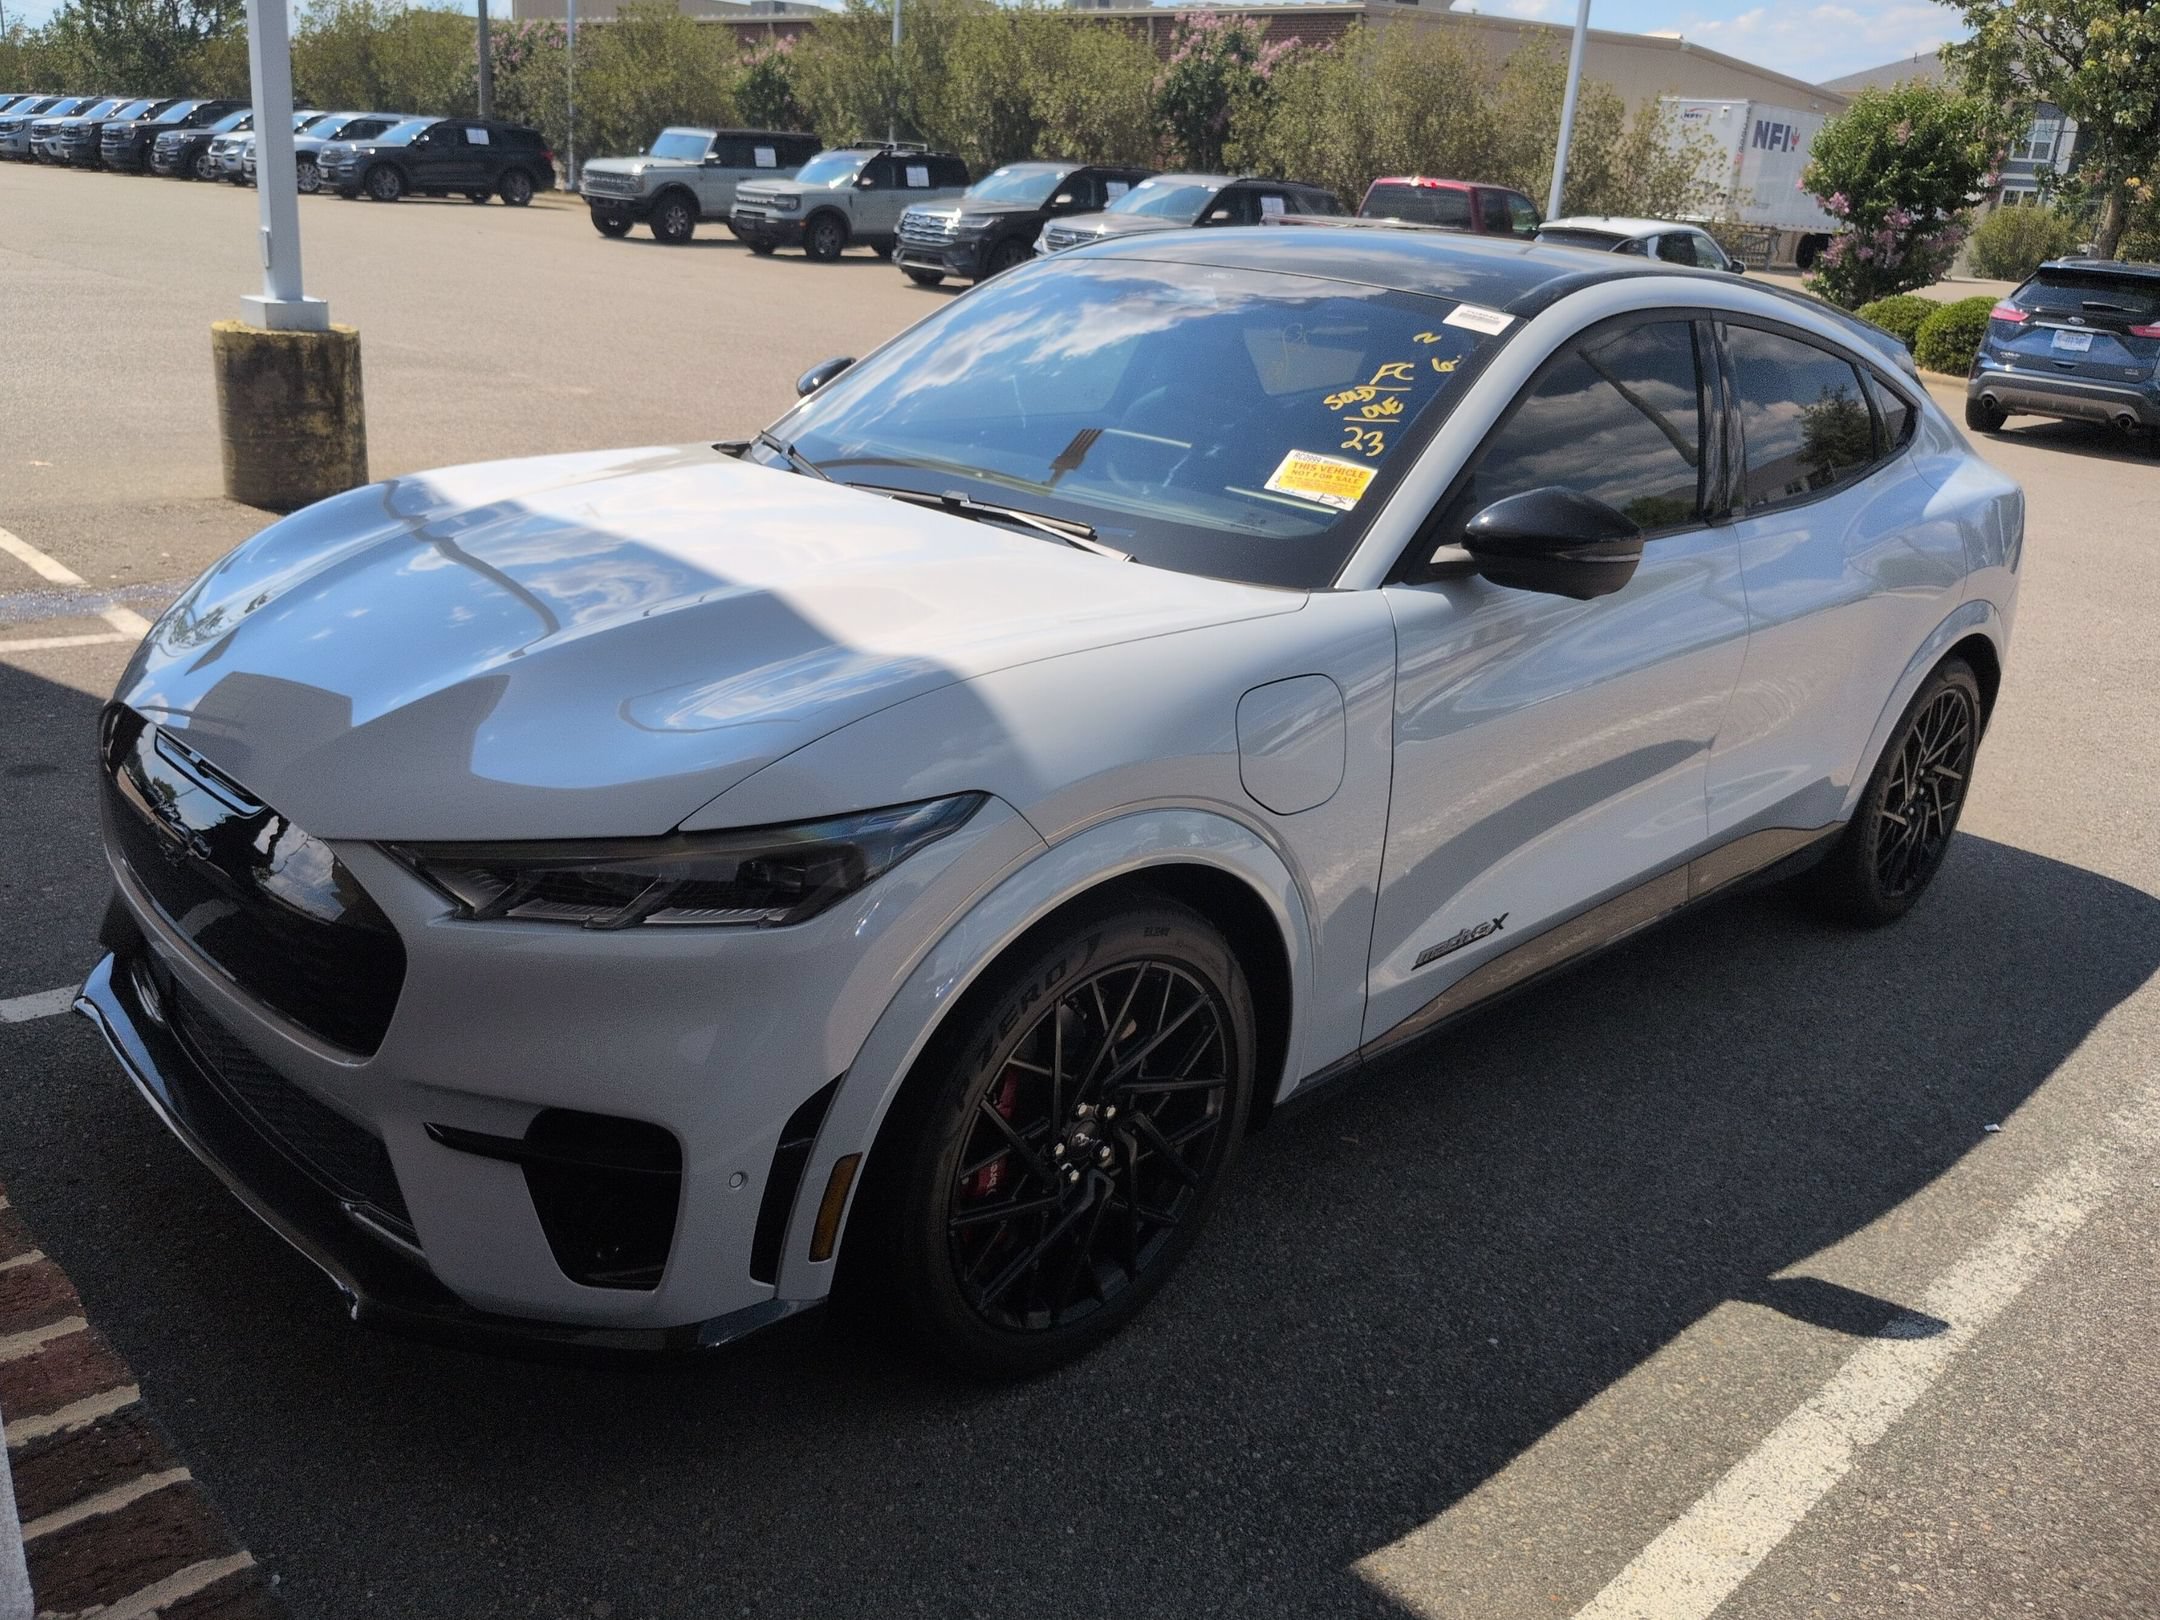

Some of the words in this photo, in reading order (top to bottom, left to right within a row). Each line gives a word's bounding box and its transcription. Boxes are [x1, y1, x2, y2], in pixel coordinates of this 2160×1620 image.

[1752, 119, 1791, 152] NFI
[1369, 362, 1415, 385] FC
[1341, 426, 1385, 457] 23
[1294, 462, 1317, 473] THIS
[1320, 464, 1367, 479] VEHICLE
[1313, 472, 1333, 480] FOR
[1335, 475, 1361, 485] SALE
